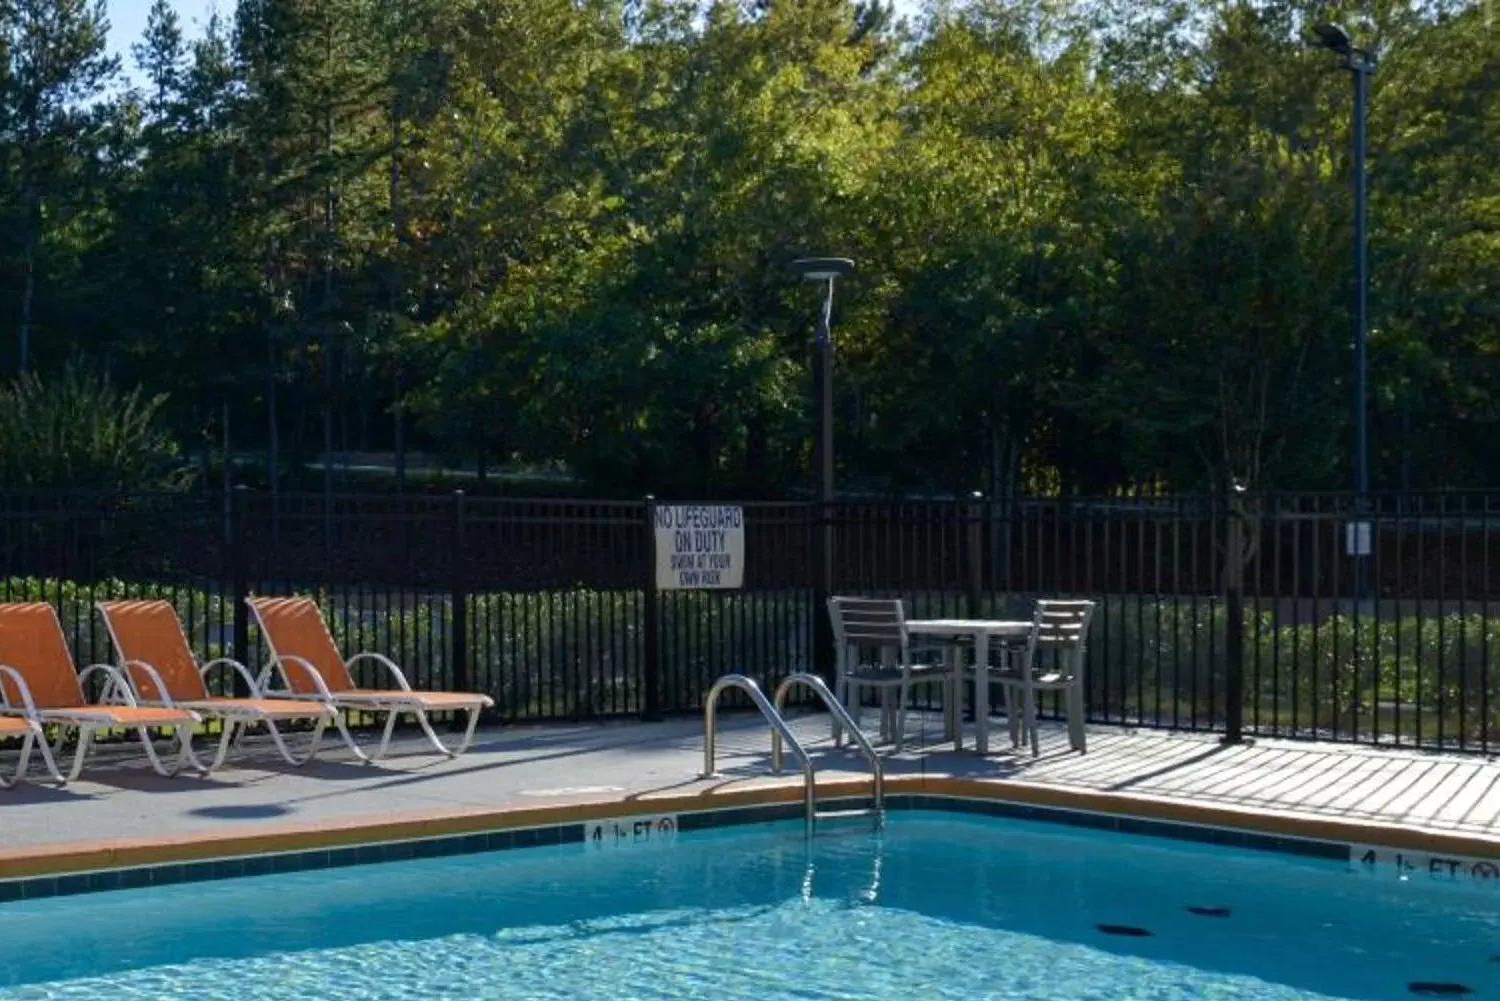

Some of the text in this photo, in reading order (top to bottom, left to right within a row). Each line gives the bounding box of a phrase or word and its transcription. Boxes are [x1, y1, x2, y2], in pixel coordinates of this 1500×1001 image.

[655, 506, 740, 529] NO LIFEGUARD
[675, 530, 725, 552] ON DUTY
[670, 553, 695, 569] SWIM
[708, 553, 731, 568] YOUR
